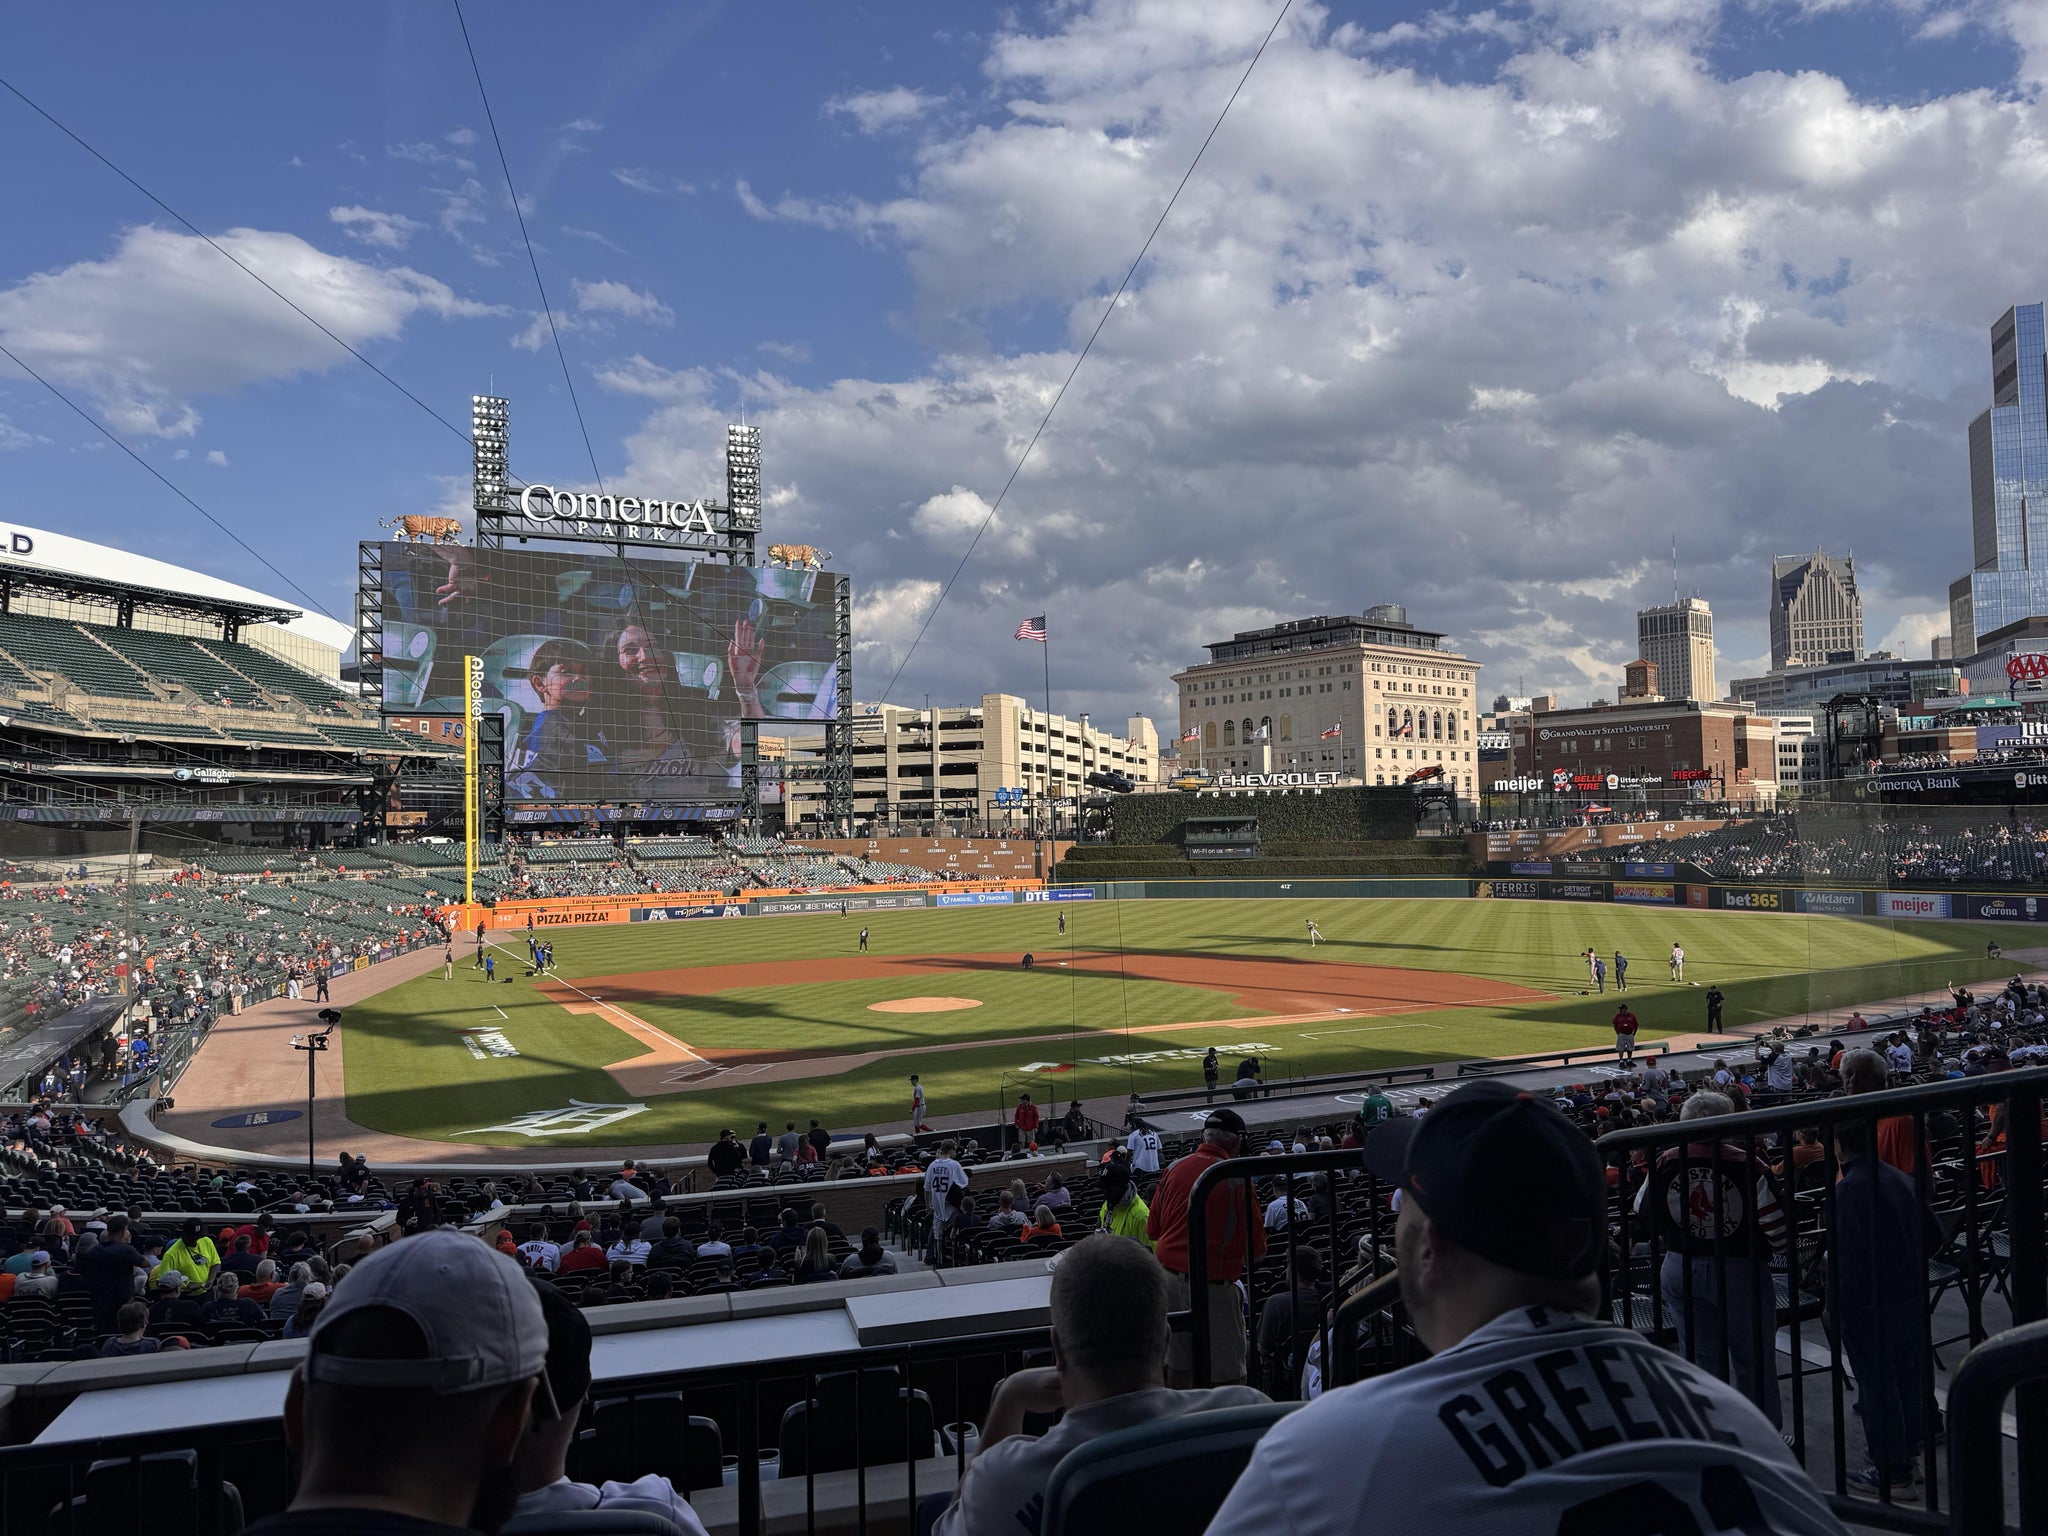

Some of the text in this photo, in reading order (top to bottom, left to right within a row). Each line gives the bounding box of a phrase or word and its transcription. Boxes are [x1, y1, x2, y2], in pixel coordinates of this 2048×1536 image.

[577, 521, 666, 541] PARK
[2007, 653, 2048, 680] AAA
[471, 671, 485, 723] Rocket
[1624, 724, 1671, 733] UNIVERSITY
[193, 768, 235, 778] Gallagher
[1672, 770, 1710, 780] FIEGER
[1218, 771, 1341, 788] CHEVROLET
[1574, 775, 1604, 783] BELLE
[1620, 776, 1662, 784] litter-robot
[1927, 776, 1960, 789] Bank
[1494, 777, 1543, 793] meijer
[1577, 782, 1600, 790] TIRE
[1687, 780, 1711, 789] LAW
[1196, 789, 1322, 798] FOUNTAIN
[99, 809, 112, 819] BOS
[275, 811, 304, 819] BOS DET
[514, 811, 547, 820] MOTOR CITY
[608, 809, 647, 818] BOS DET
[1586, 829, 1597, 837] 10
[1626, 825, 1635, 834] 11
[1664, 824, 1676, 832] 42
[648, 837, 695, 845] CHEVROLET
[1495, 883, 1536, 893] FERRIS
[1618, 886, 1651, 898] Surfside
[1026, 891, 1050, 901] DTE
[1725, 891, 1778, 908] bet365
[1816, 893, 1855, 905] McLaren
[768, 903, 801, 912] BETMGM
[1891, 897, 1935, 915] meijer
[1981, 903, 2018, 917] Corona
[537, 911, 609, 925] PIZZA! PIZZA!
[1376, 1106, 1388, 1120] 16
[1143, 1137, 1156, 1151] 12
[932, 1176, 949, 1193] 45
[526, 1244, 545, 1253] ORTIZ
[1438, 1344, 1742, 1487] GREENE
